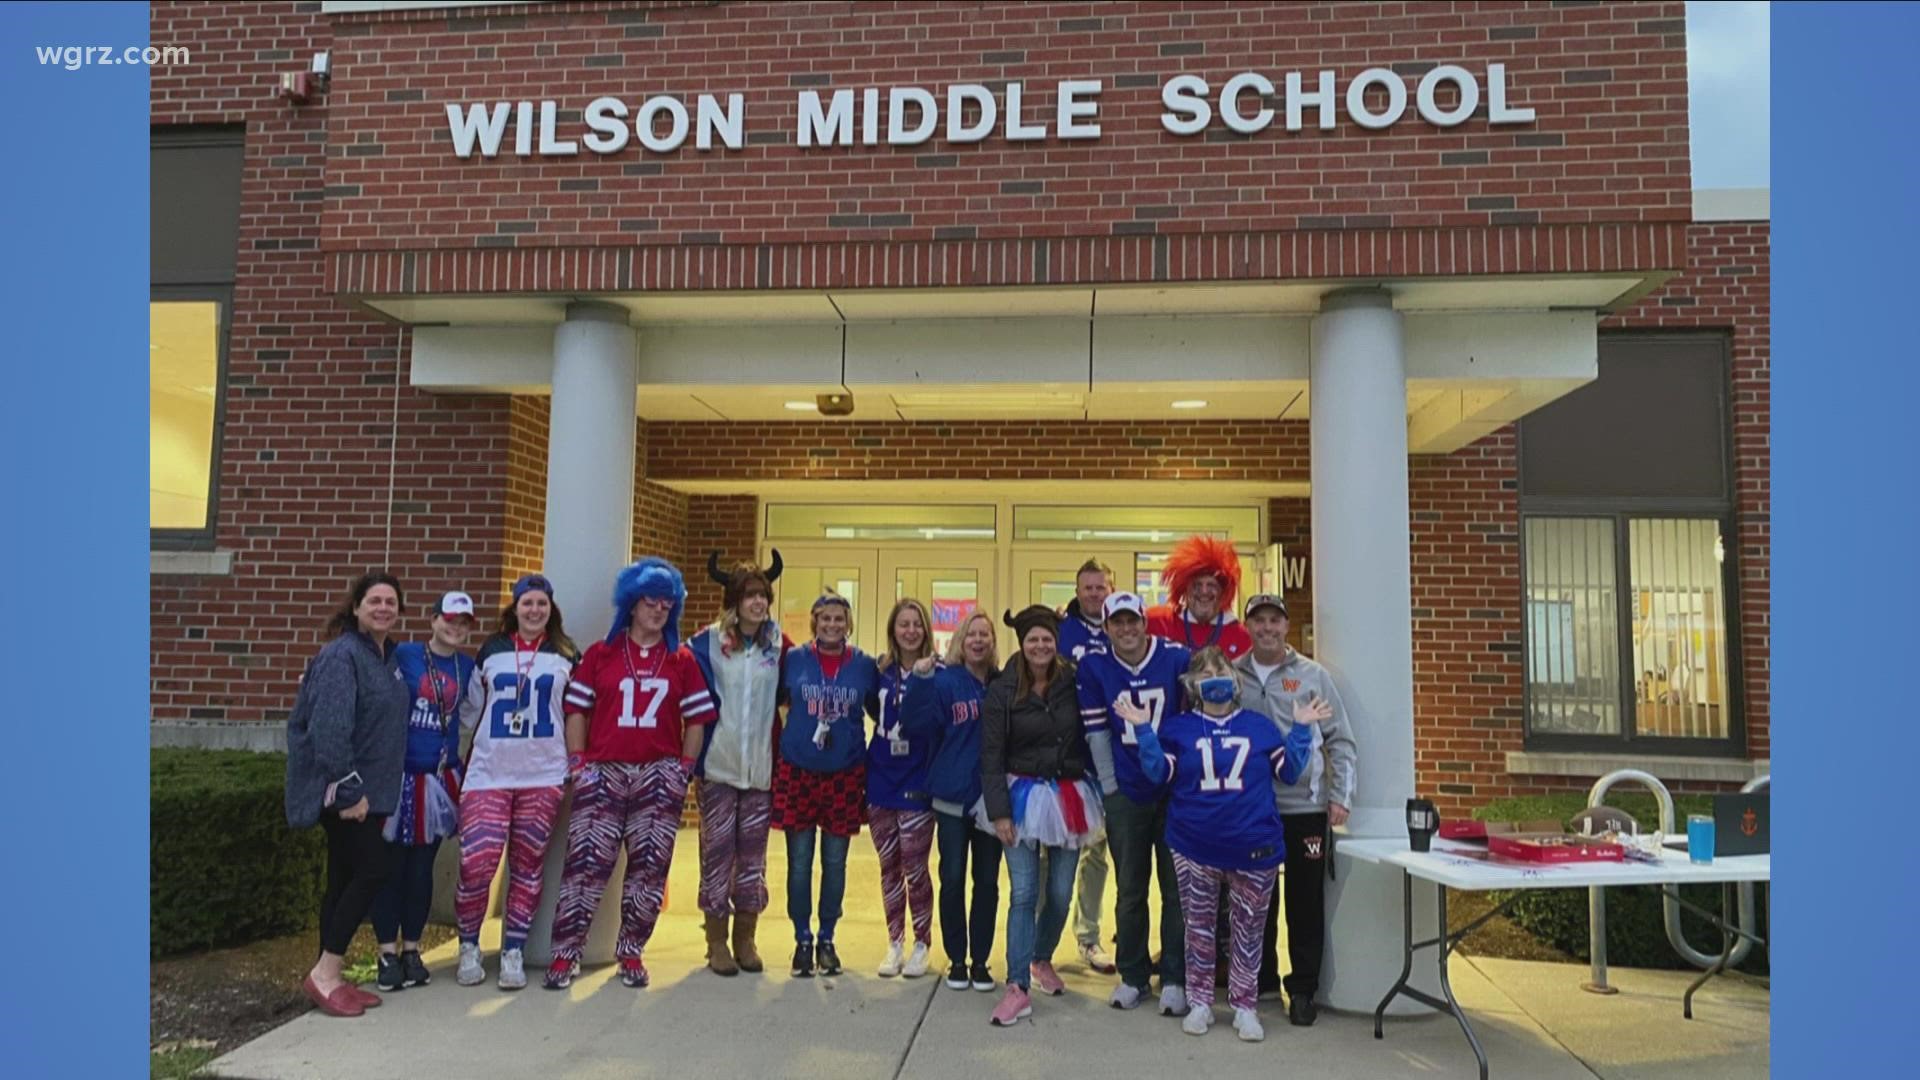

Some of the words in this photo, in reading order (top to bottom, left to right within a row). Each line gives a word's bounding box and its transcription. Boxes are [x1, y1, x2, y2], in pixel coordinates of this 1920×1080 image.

[446, 93, 744, 157] WILSON
[797, 81, 1102, 146] MIDDLE
[1160, 63, 1536, 134] SCHOOL
[490, 673, 554, 738] 21
[618, 678, 669, 727] 17
[1117, 688, 1165, 744] 17
[1195, 737, 1250, 791] 17
[1307, 842, 1321, 855] W
